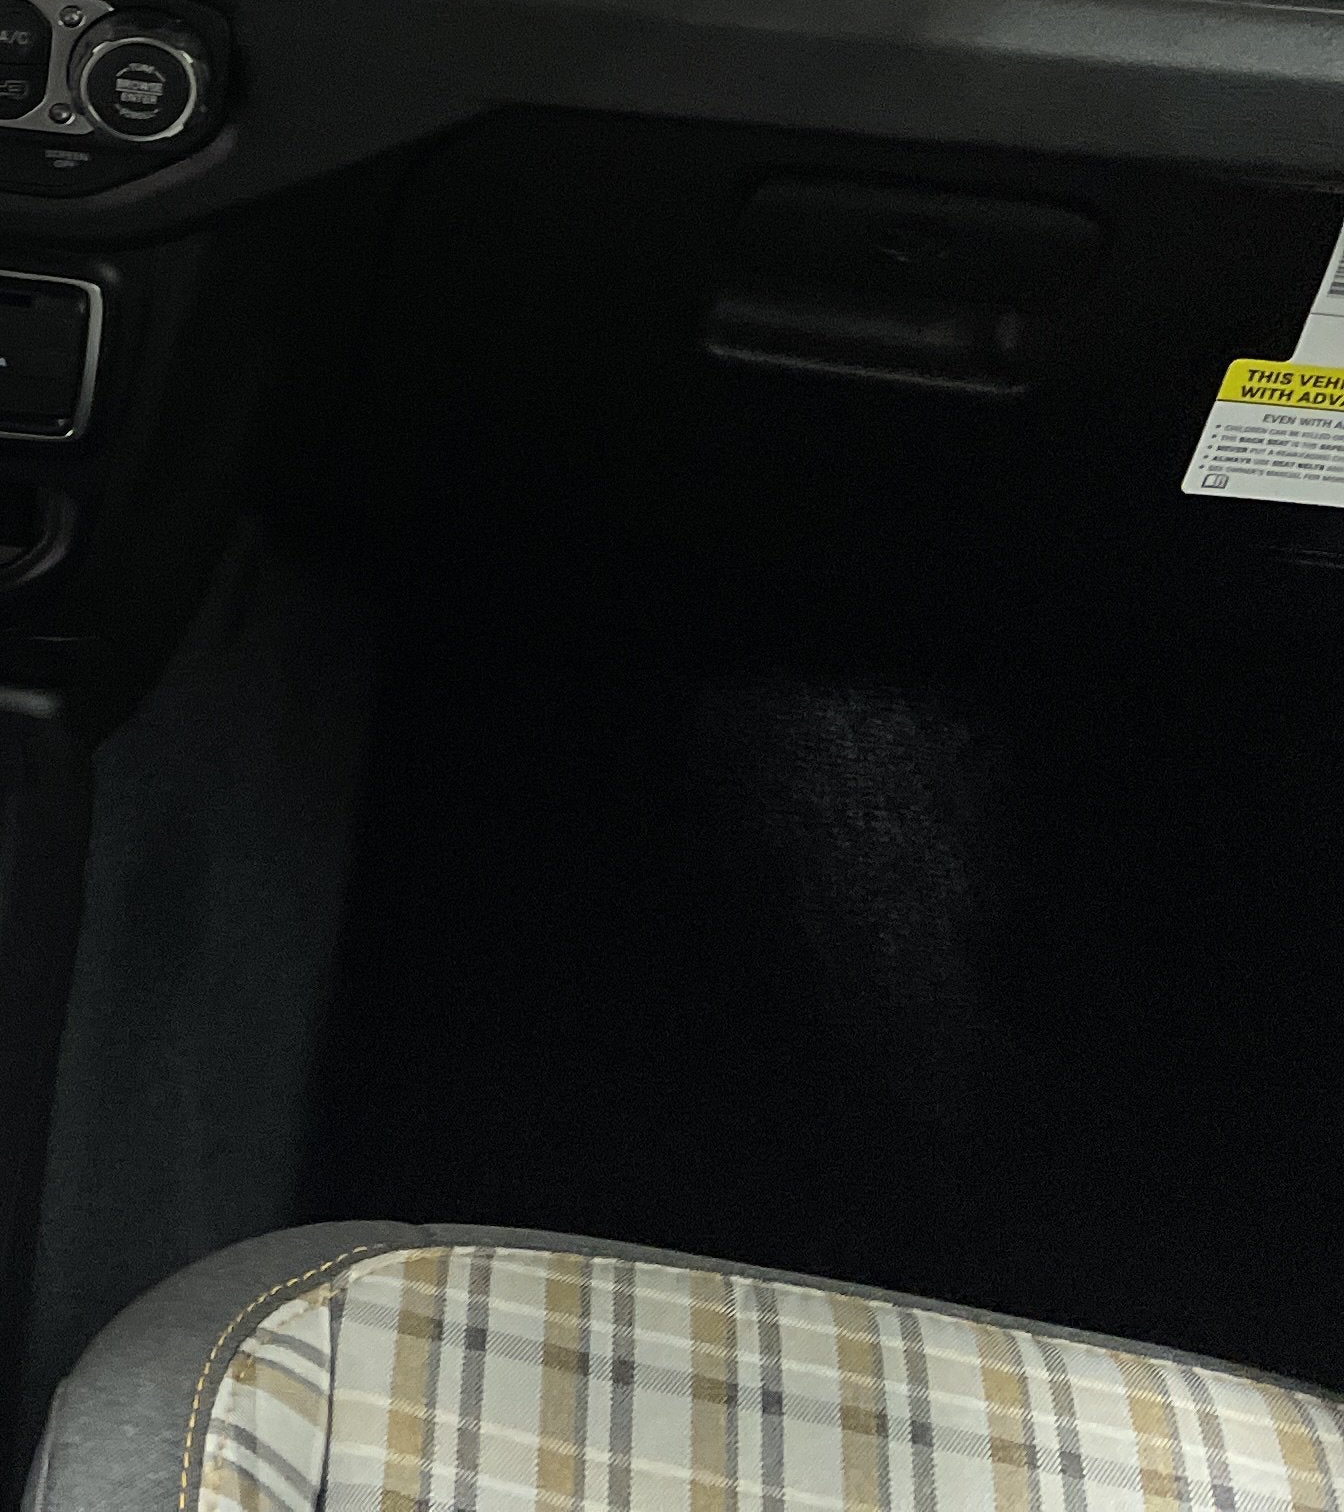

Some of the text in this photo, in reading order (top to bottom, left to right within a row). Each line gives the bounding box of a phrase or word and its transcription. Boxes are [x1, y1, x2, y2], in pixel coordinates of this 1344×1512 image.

[1247, 369, 1294, 386] THIS
[1241, 385, 1294, 401] WITH
[1262, 413, 1297, 425] EVEN
